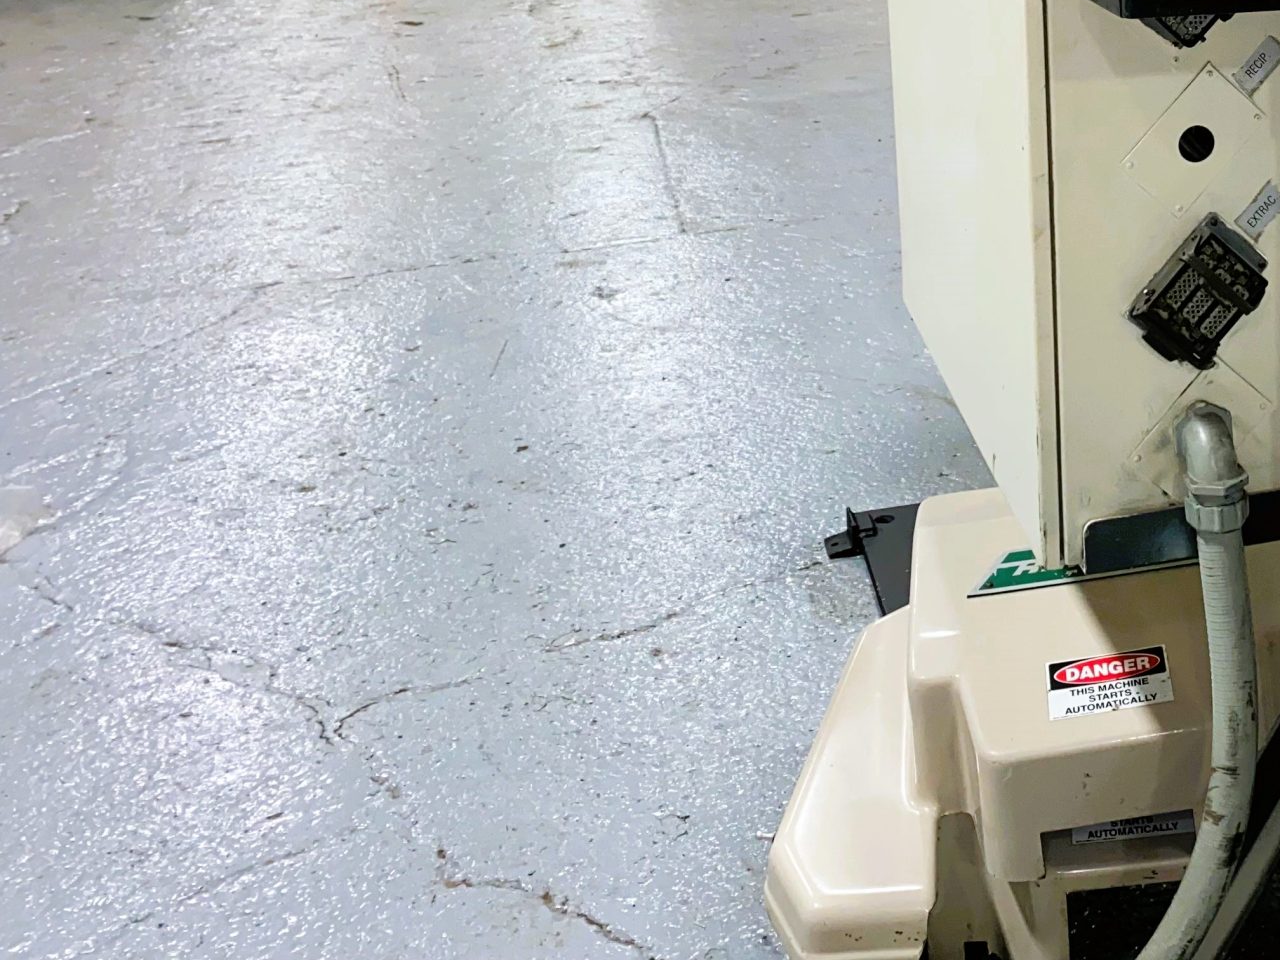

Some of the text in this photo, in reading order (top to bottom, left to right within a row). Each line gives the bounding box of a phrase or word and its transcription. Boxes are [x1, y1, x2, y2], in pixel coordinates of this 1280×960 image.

[1247, 195, 1276, 228] EXTRAC
[1065, 656, 1150, 682] DANGER
[1070, 678, 1150, 696] THIS MACHINE
[1088, 688, 1132, 702] STARTS
[1065, 692, 1158, 715] AUTOMATICALLY
[1087, 822, 1178, 840] AUTOMATICALLY
